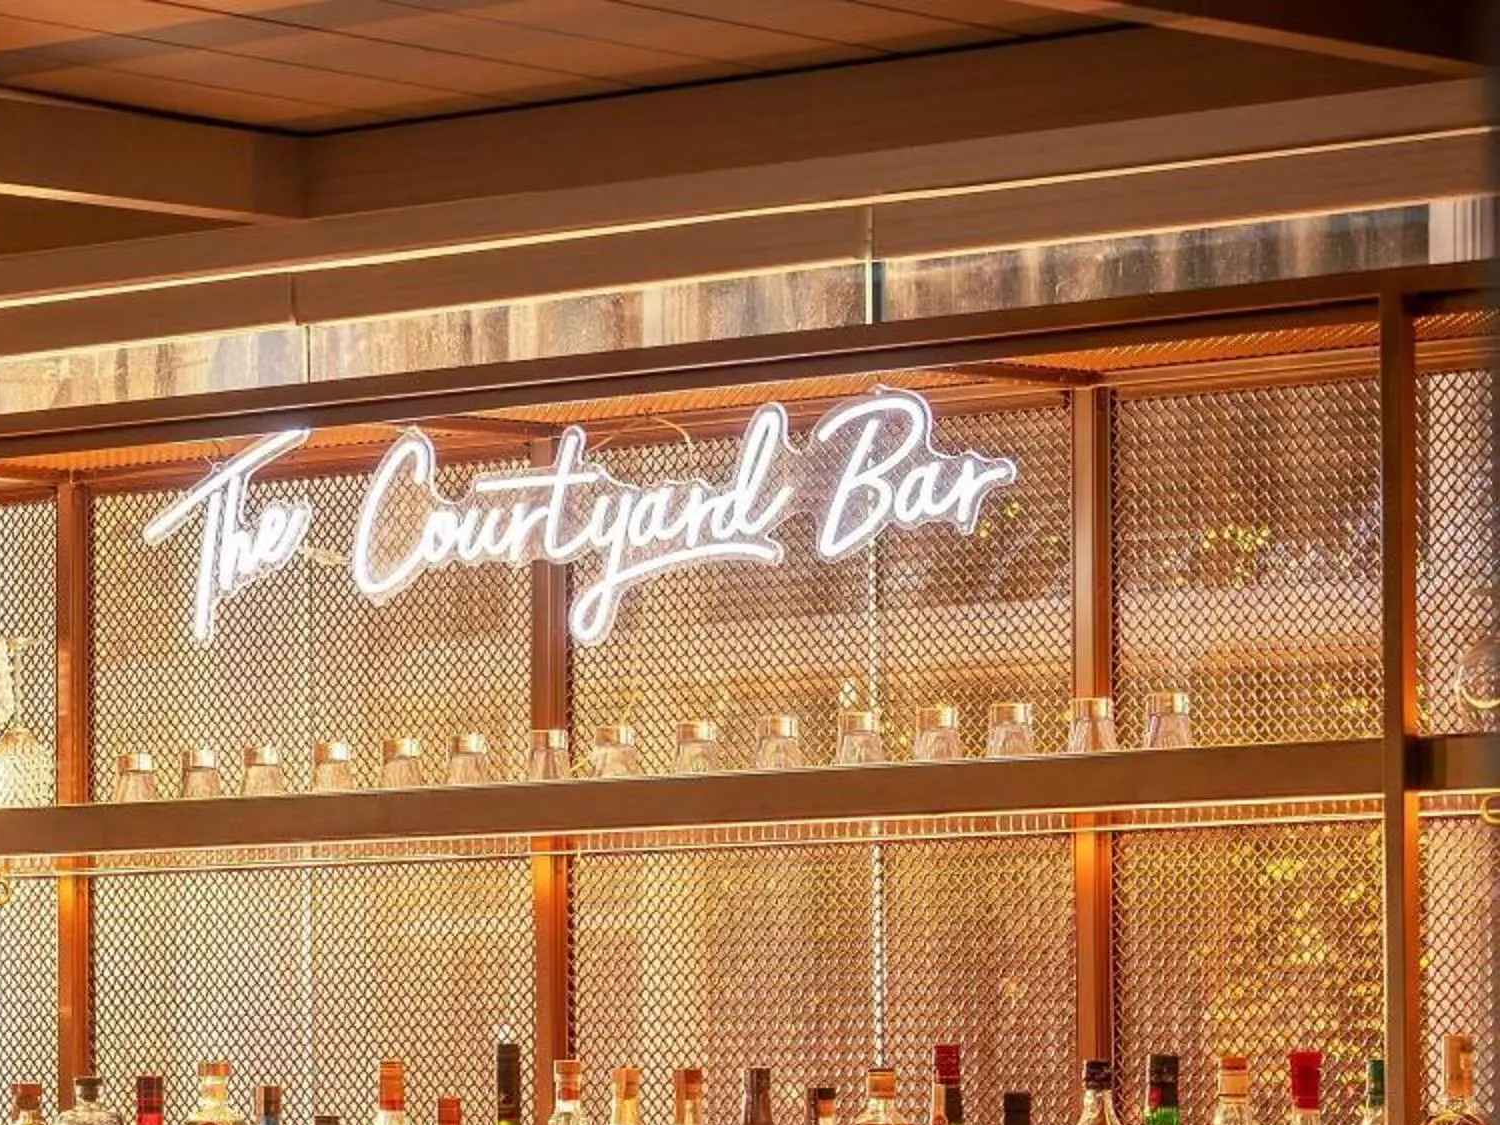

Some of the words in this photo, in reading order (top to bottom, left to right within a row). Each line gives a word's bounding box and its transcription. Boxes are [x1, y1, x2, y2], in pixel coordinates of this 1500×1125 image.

[145, 428, 308, 643] The
[354, 402, 790, 643] Courtyard
[813, 393, 1014, 558] Bar
